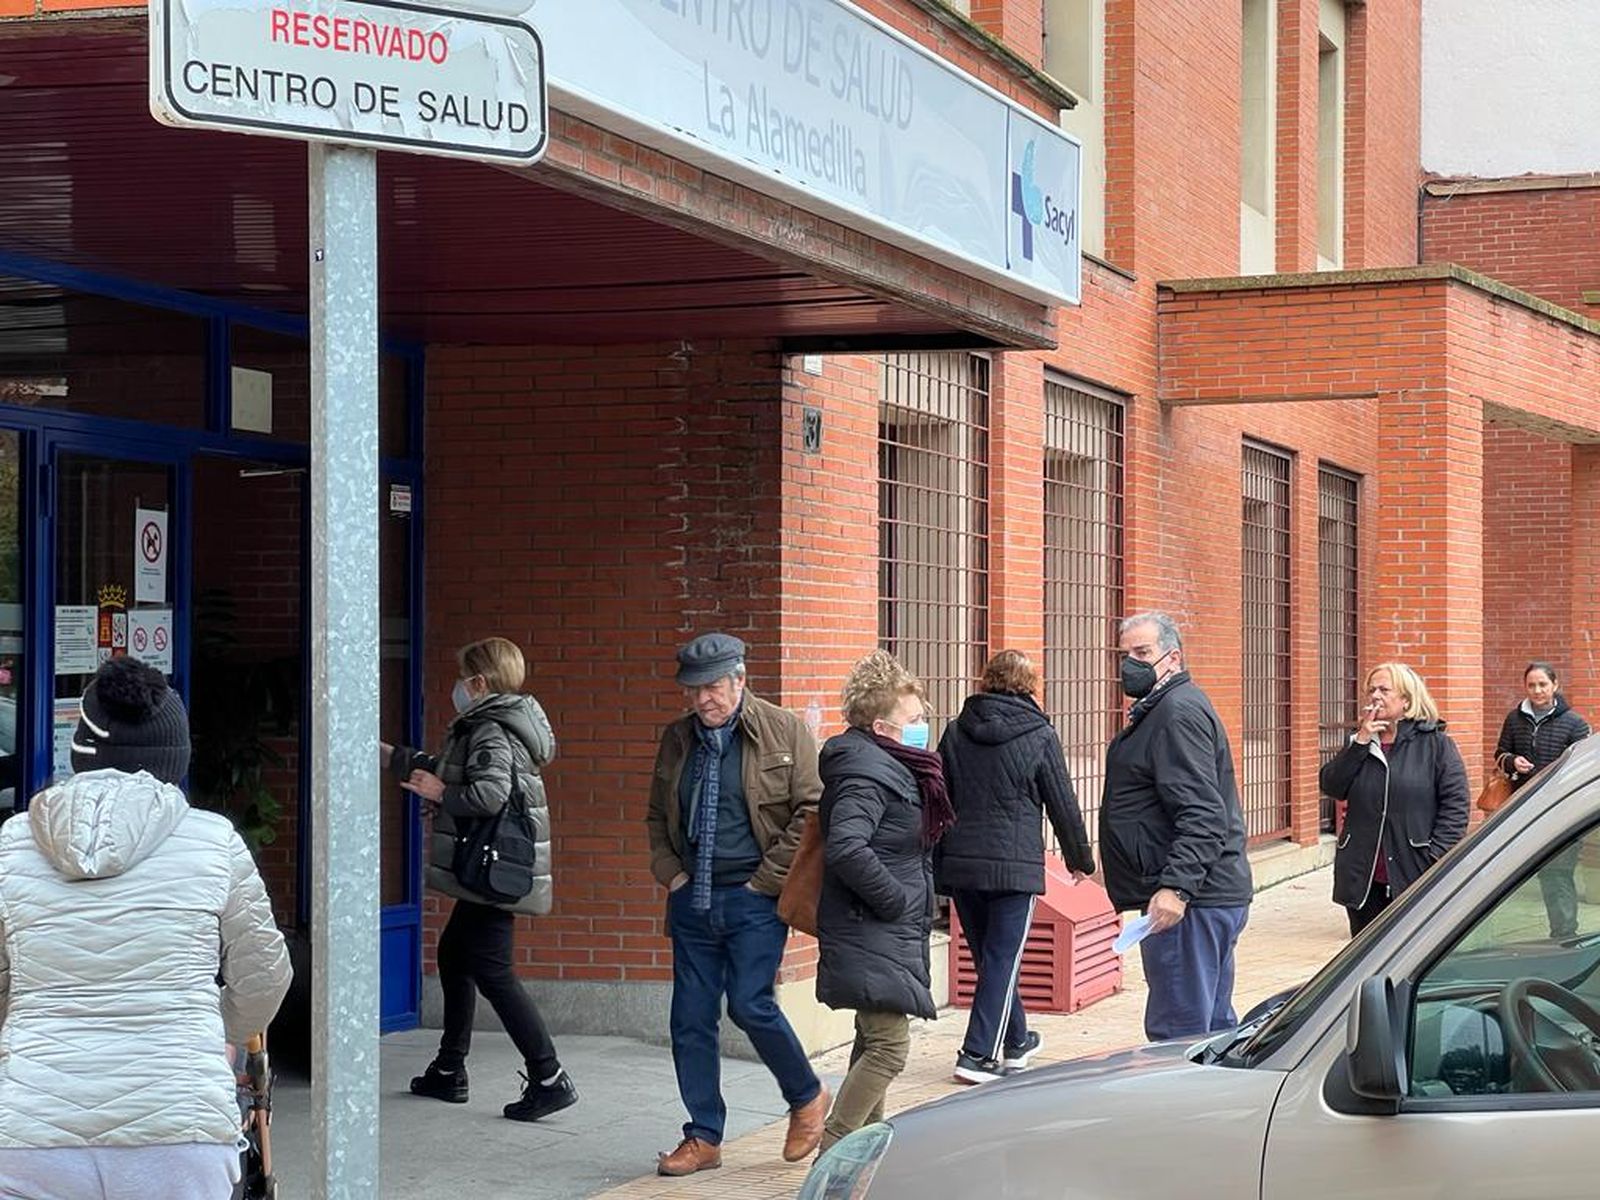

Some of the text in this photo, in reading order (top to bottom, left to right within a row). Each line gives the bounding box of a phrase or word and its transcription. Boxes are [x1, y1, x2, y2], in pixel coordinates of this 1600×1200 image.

[271, 9, 448, 65] RESERVADO
[783, 0, 825, 88] DE
[829, 22, 913, 130] SALUD
[183, 60, 529, 133] CENTRO DE SALUD
[703, 59, 867, 197] La Alamedilla
[1044, 195, 1075, 245] Sacyl
